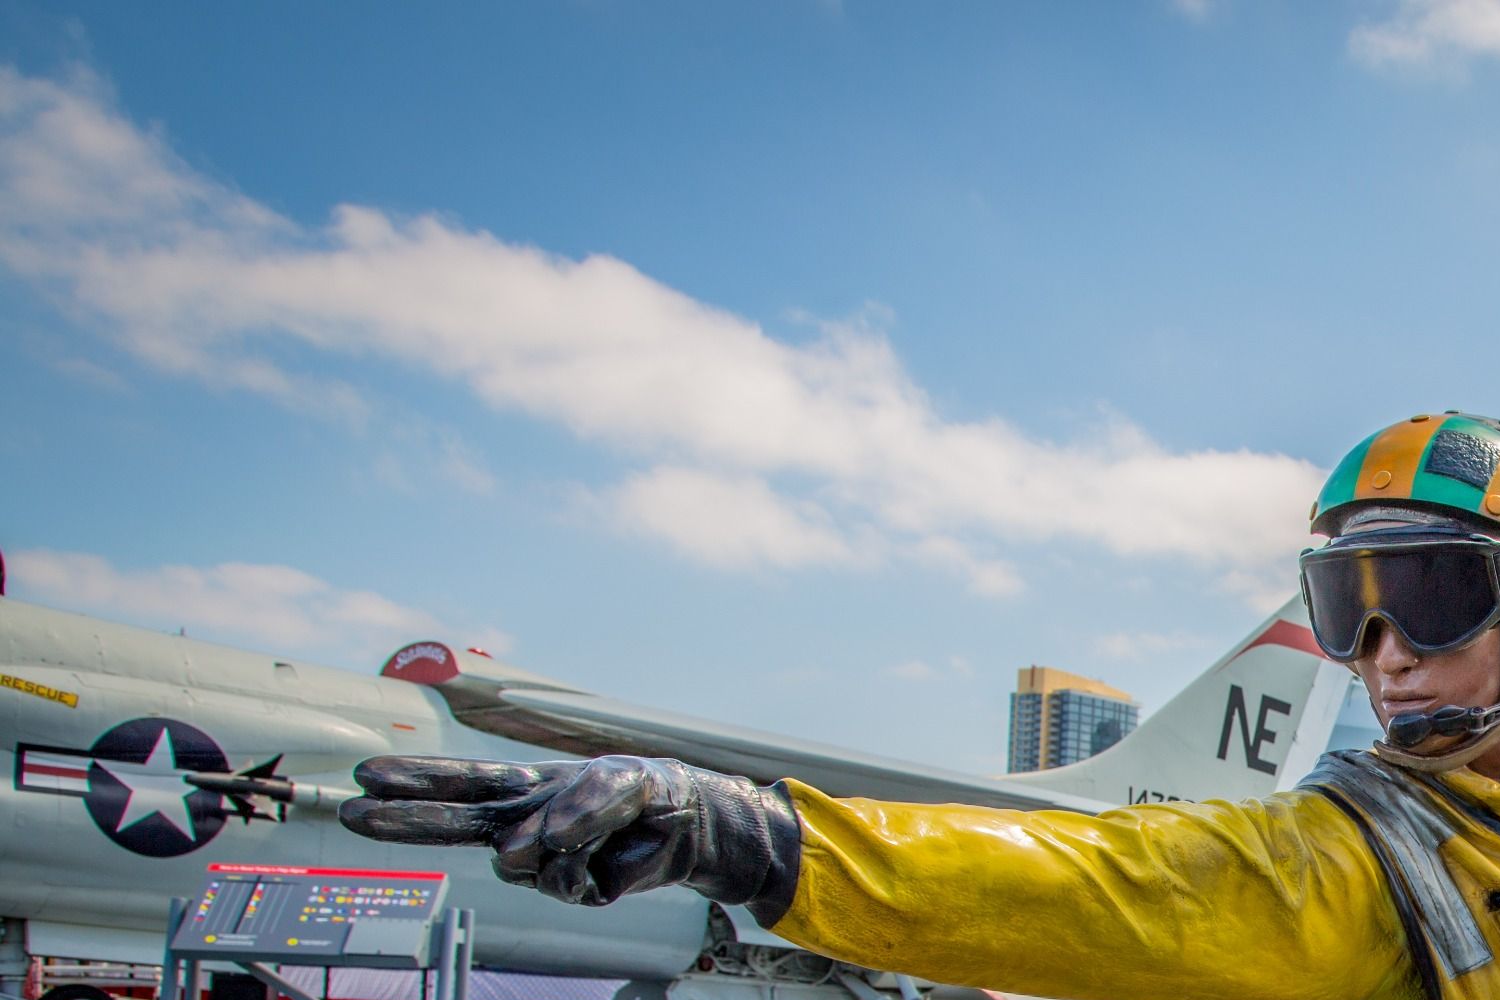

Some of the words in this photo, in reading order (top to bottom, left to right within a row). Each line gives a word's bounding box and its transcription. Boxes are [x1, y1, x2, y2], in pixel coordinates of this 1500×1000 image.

[1, 675, 69, 705] RESCUE
[1216, 683, 1292, 777] NE
[1129, 786, 1196, 805] 147
